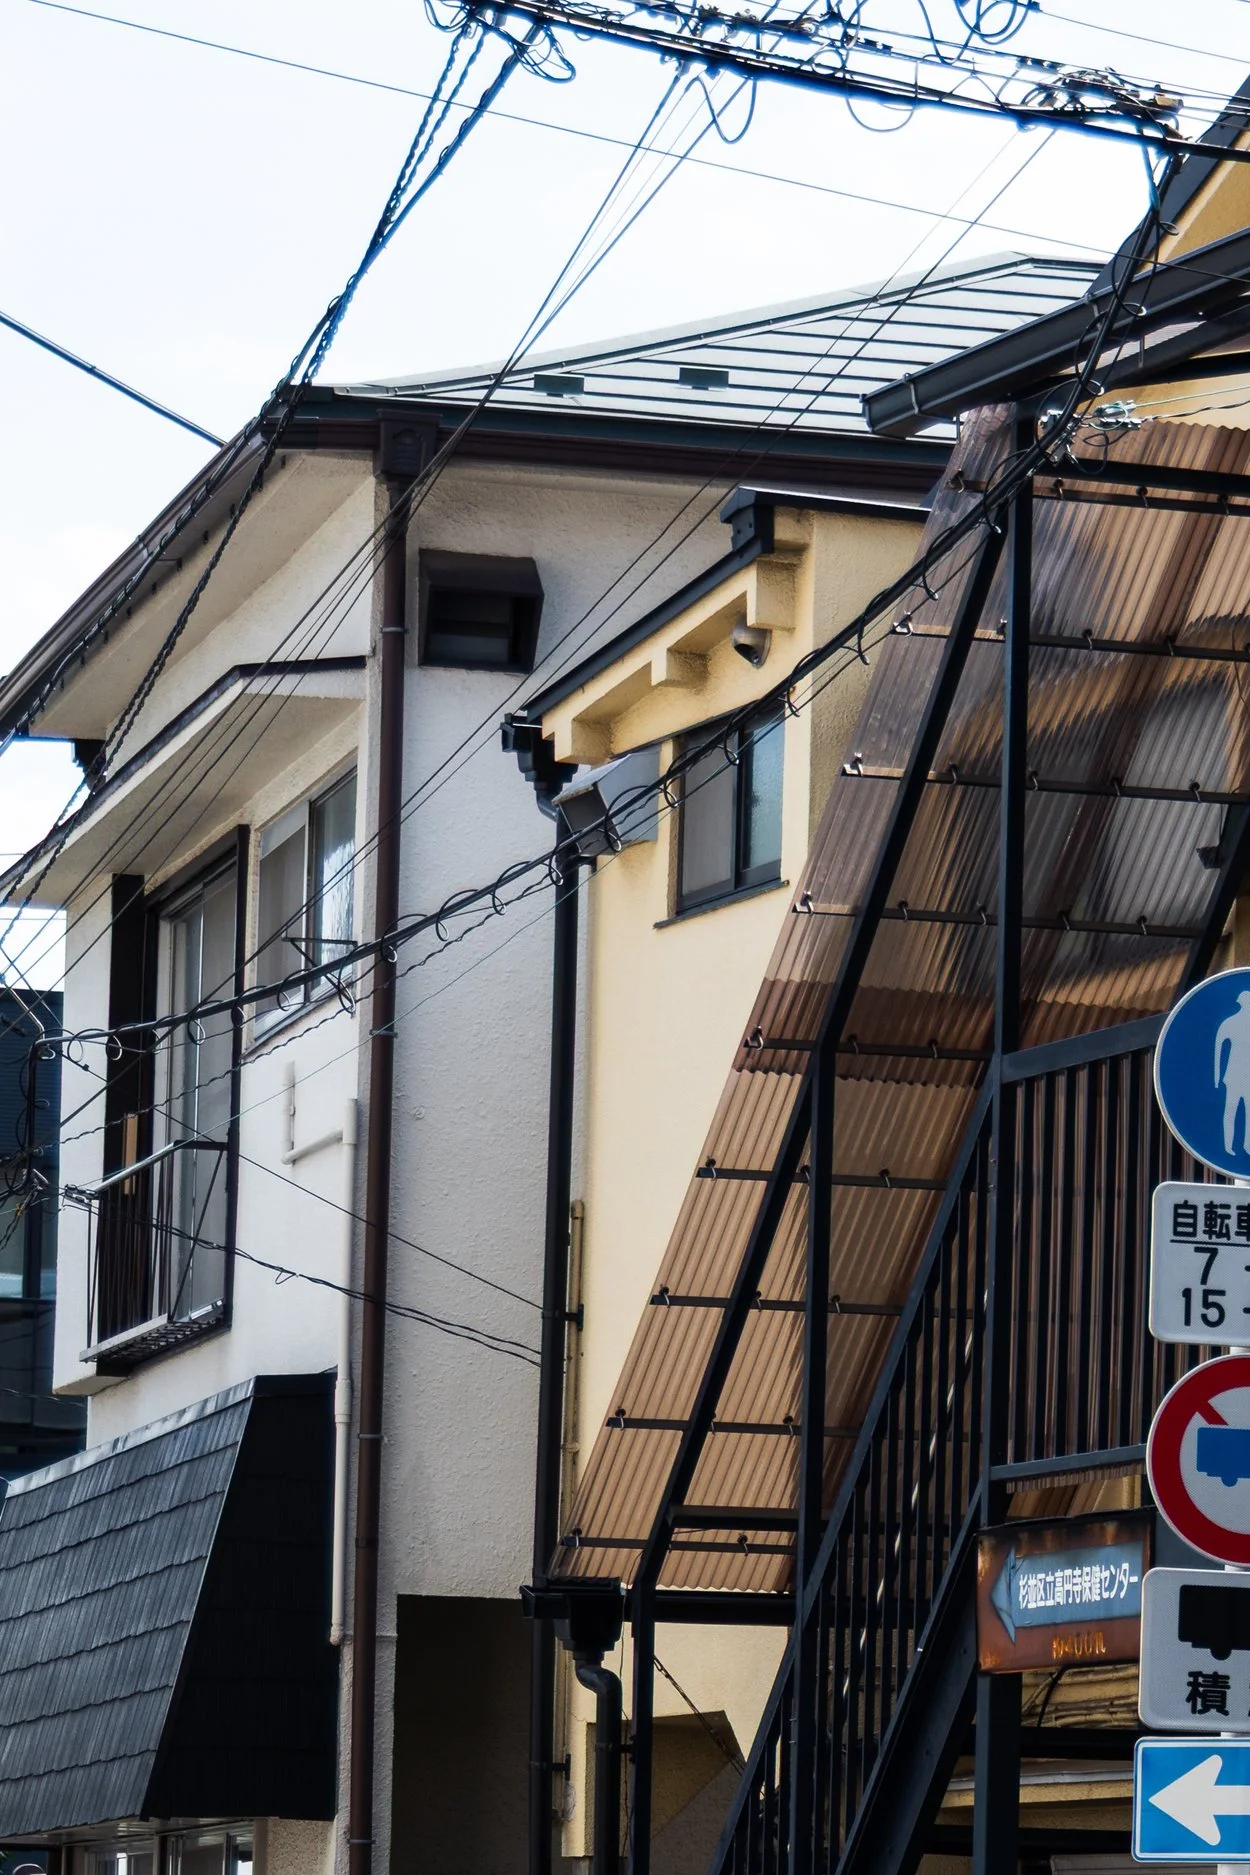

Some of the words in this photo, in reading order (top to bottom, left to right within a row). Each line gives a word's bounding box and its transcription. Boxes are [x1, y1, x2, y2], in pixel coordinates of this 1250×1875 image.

[1018, 1563, 1138, 1609] 杉並区立高円寺保健センター
